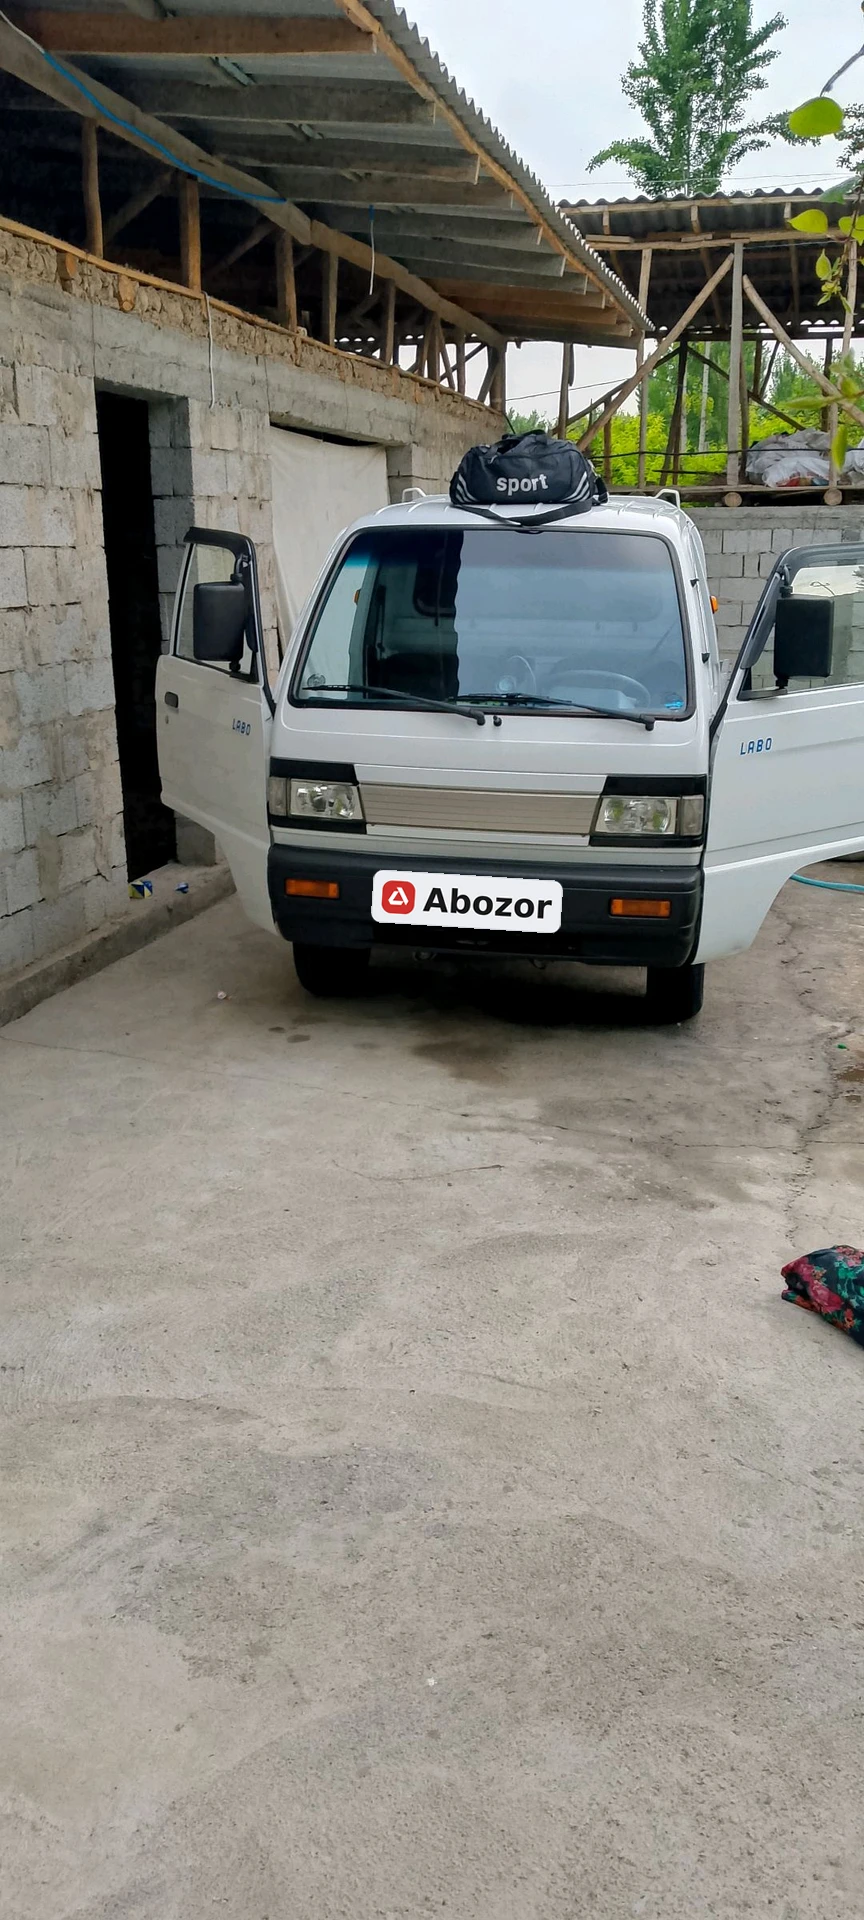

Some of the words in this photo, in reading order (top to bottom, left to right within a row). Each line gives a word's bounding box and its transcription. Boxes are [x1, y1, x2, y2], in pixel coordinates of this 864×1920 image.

[496, 473, 549, 496] sport
[232, 718, 251, 736] LABO
[740, 737, 773, 755] LABO
